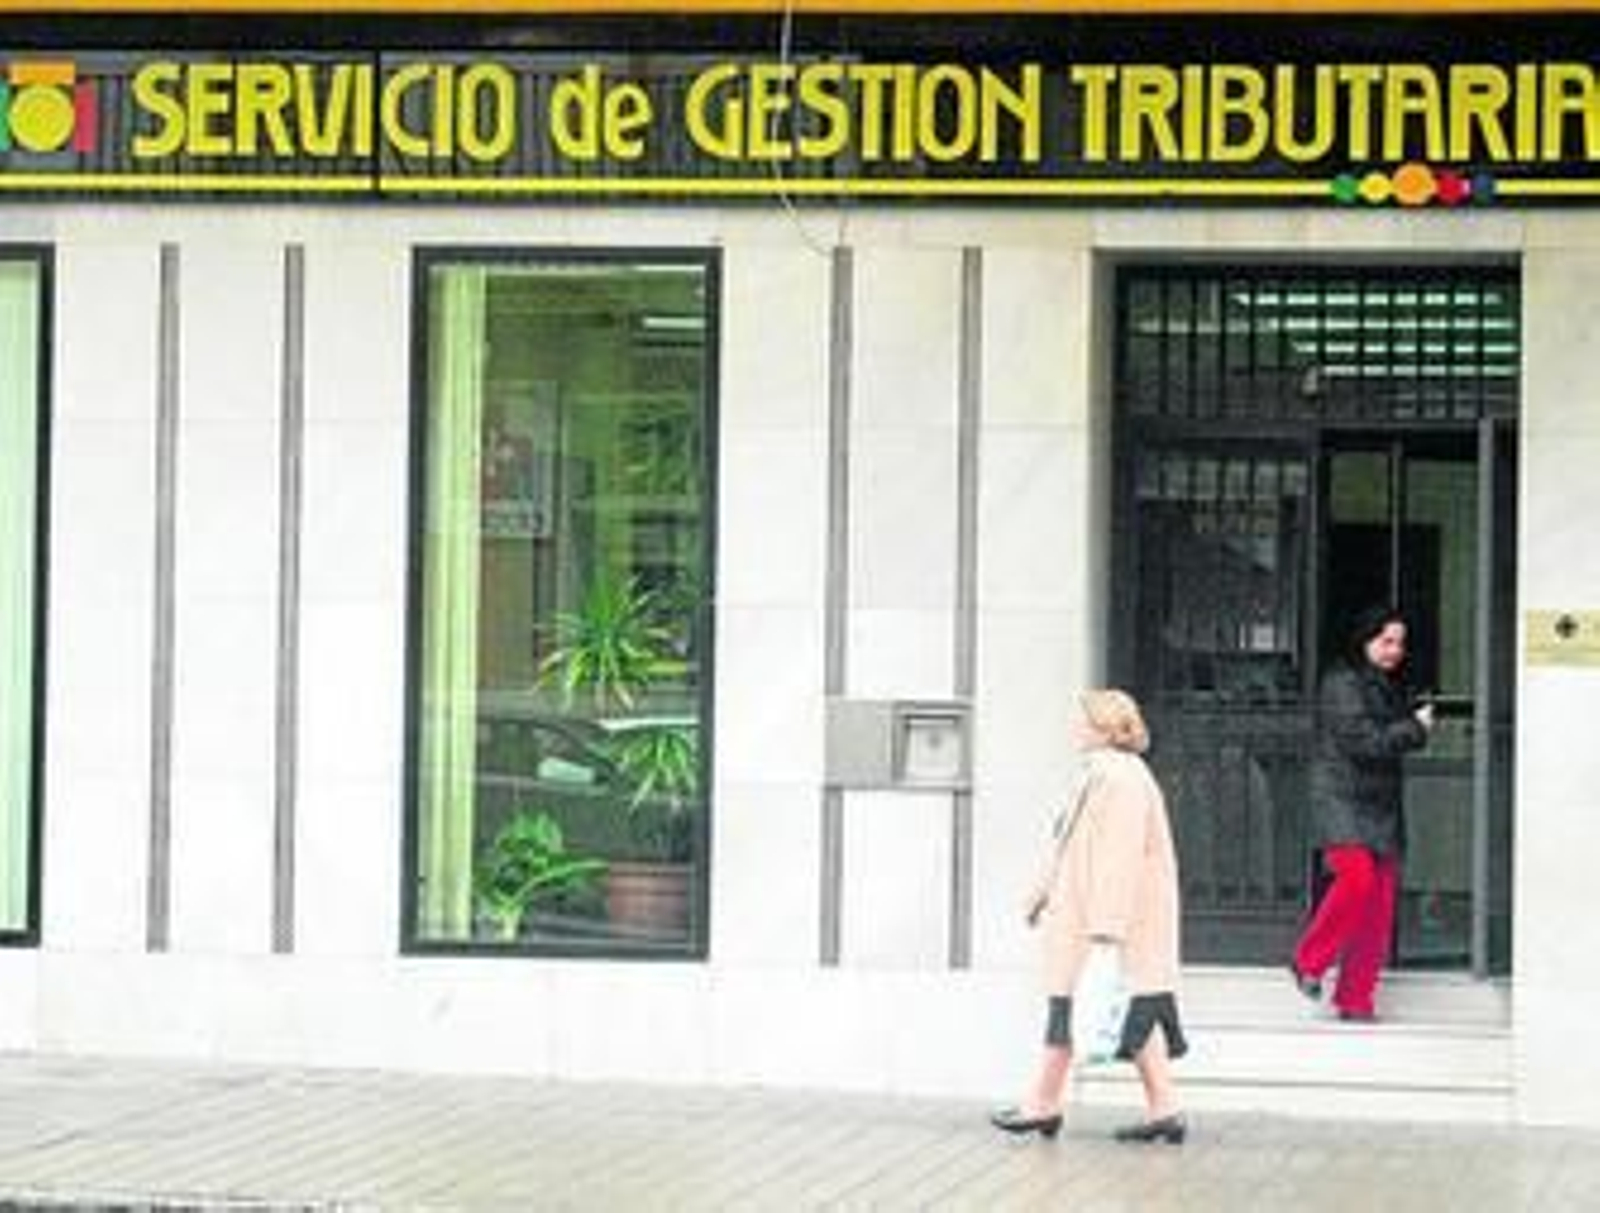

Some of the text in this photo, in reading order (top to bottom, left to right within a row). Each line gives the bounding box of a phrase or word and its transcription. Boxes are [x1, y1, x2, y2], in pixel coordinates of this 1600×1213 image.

[131, 62, 1600, 162] SERVICIO de GESTION TRIBUTARIA
